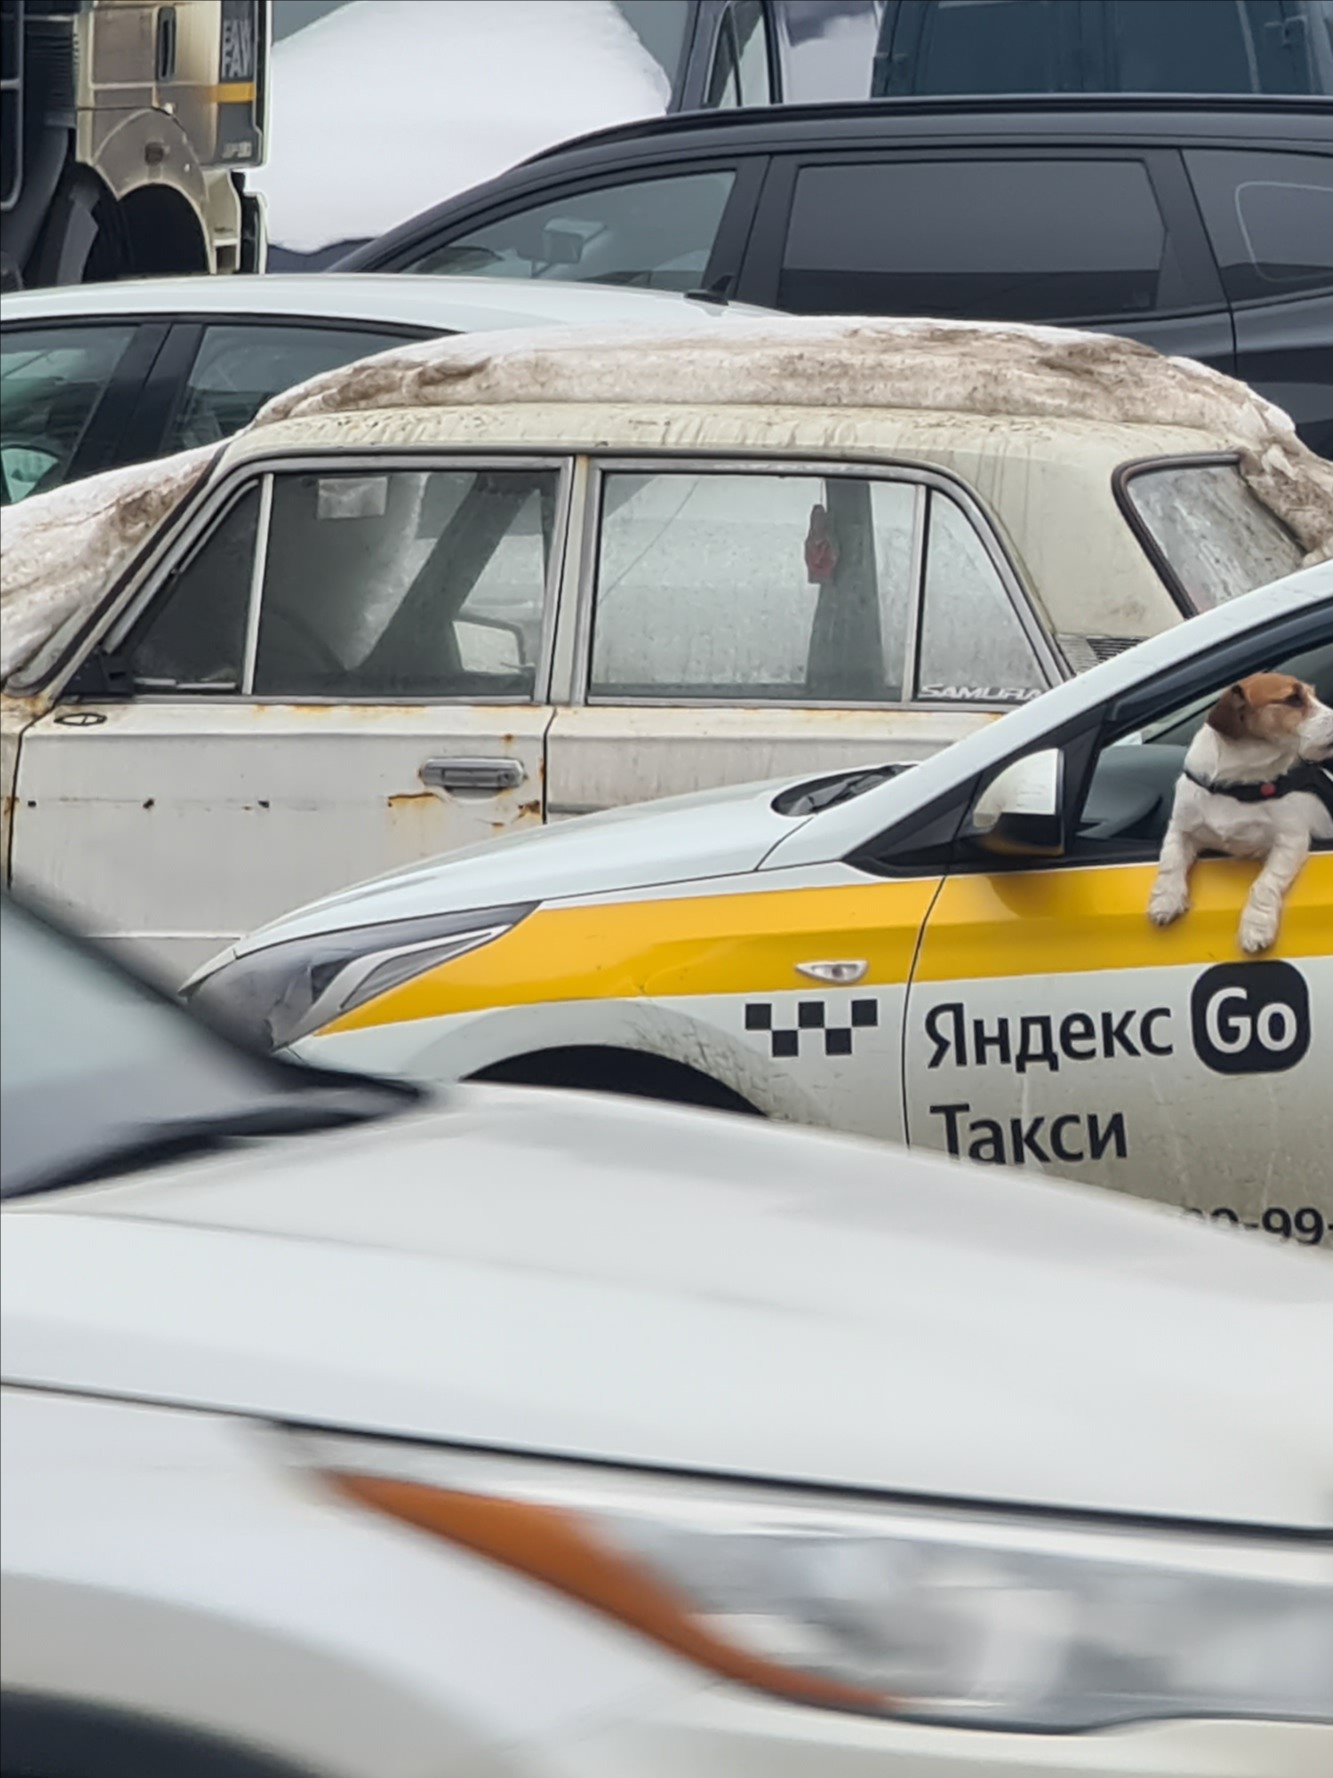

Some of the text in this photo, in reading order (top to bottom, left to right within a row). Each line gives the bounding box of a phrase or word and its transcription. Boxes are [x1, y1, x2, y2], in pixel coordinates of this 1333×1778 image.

[923, 986, 1298, 1073] Яндекс Go
[929, 1103, 1128, 1165] Такси
